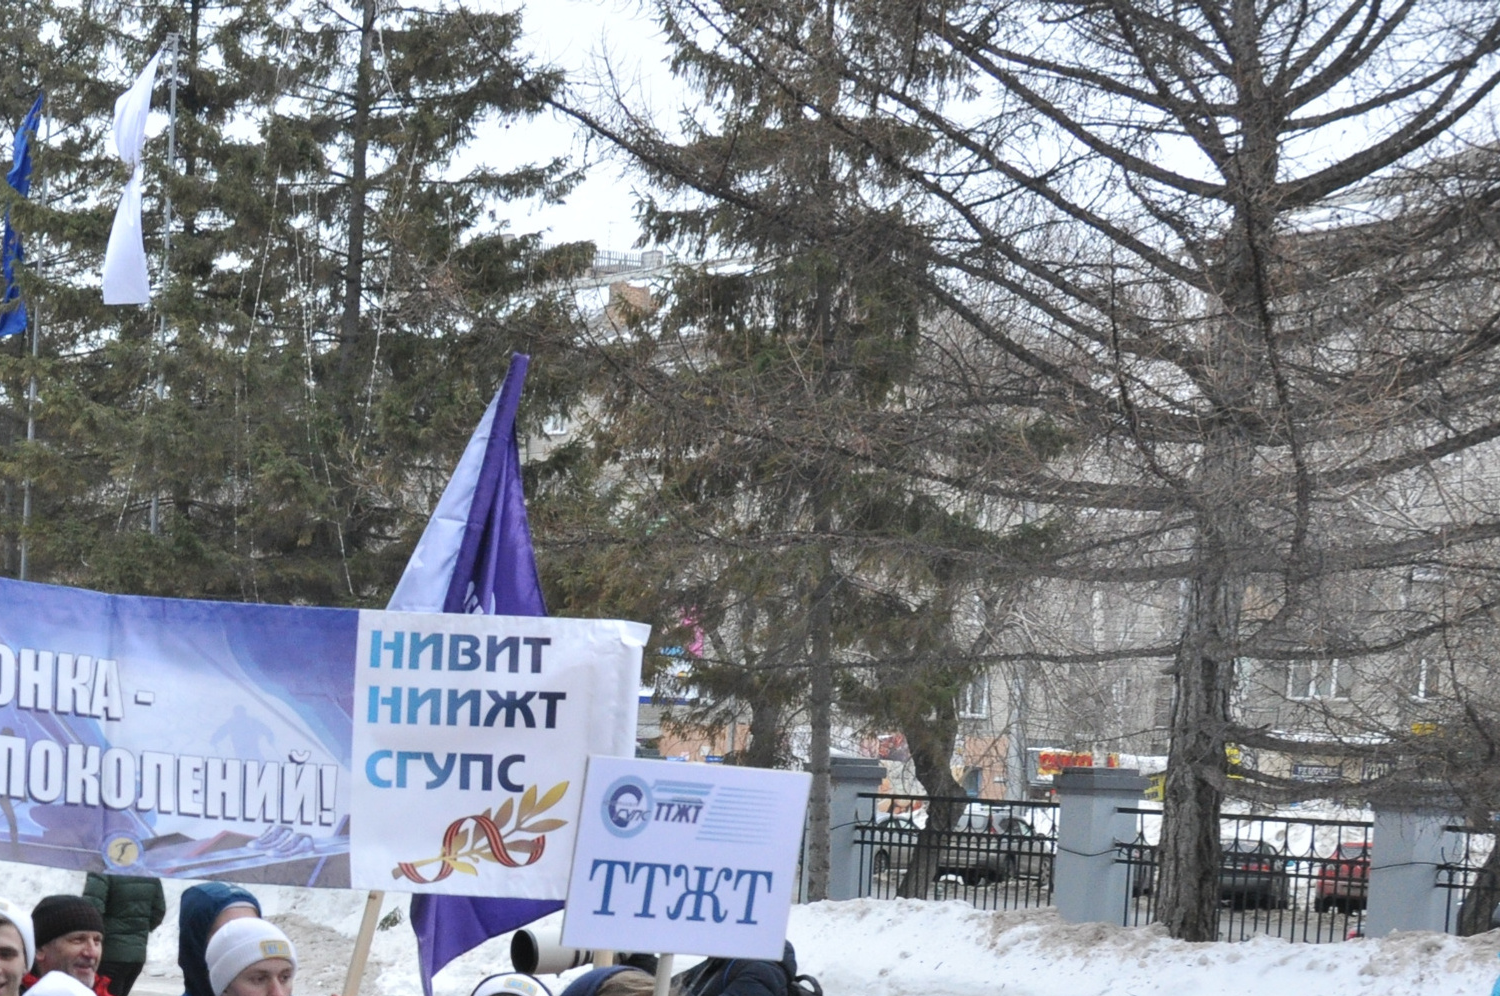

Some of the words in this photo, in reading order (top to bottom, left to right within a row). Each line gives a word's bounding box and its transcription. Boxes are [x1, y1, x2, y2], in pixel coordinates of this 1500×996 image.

[369, 630, 552, 674] НИВИТ
[367, 685, 567, 729] НИИЖТ
[365, 749, 526, 793] СГУПС
[589, 858, 773, 925] ТТЖТ
